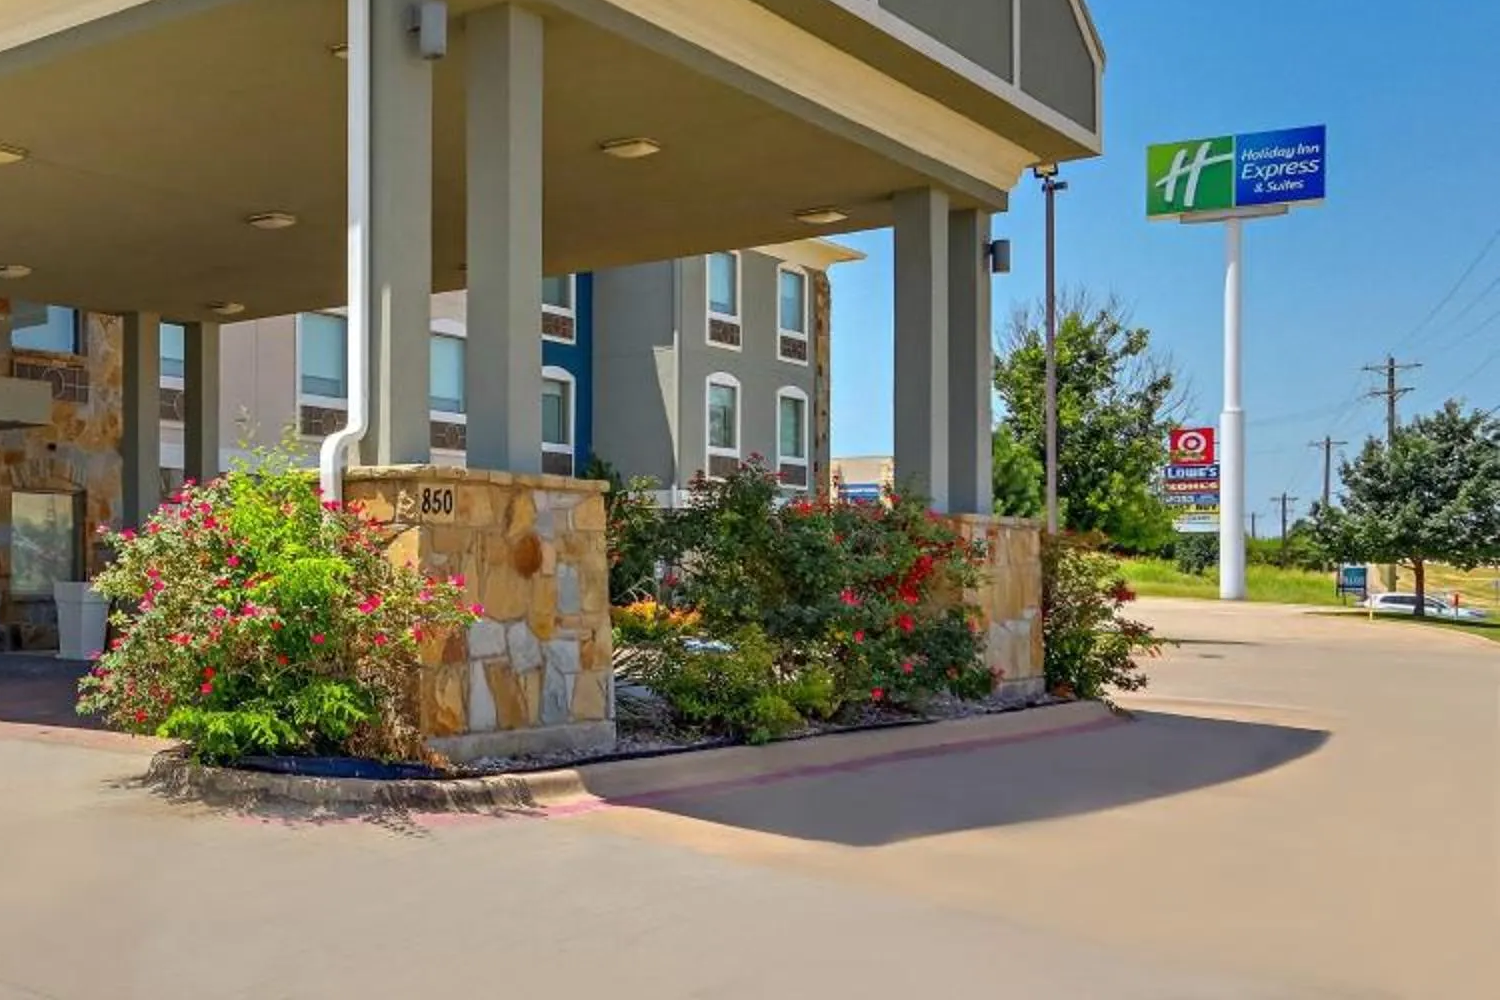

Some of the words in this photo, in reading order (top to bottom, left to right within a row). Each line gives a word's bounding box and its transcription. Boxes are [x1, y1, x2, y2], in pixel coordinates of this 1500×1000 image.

[1241, 146, 1295, 161] Holiday
[1296, 143, 1320, 155] Inn
[1241, 159, 1320, 180] Express
[1253, 182, 1264, 193] &
[1265, 179, 1304, 193] Suites
[421, 487, 453, 515] 850
